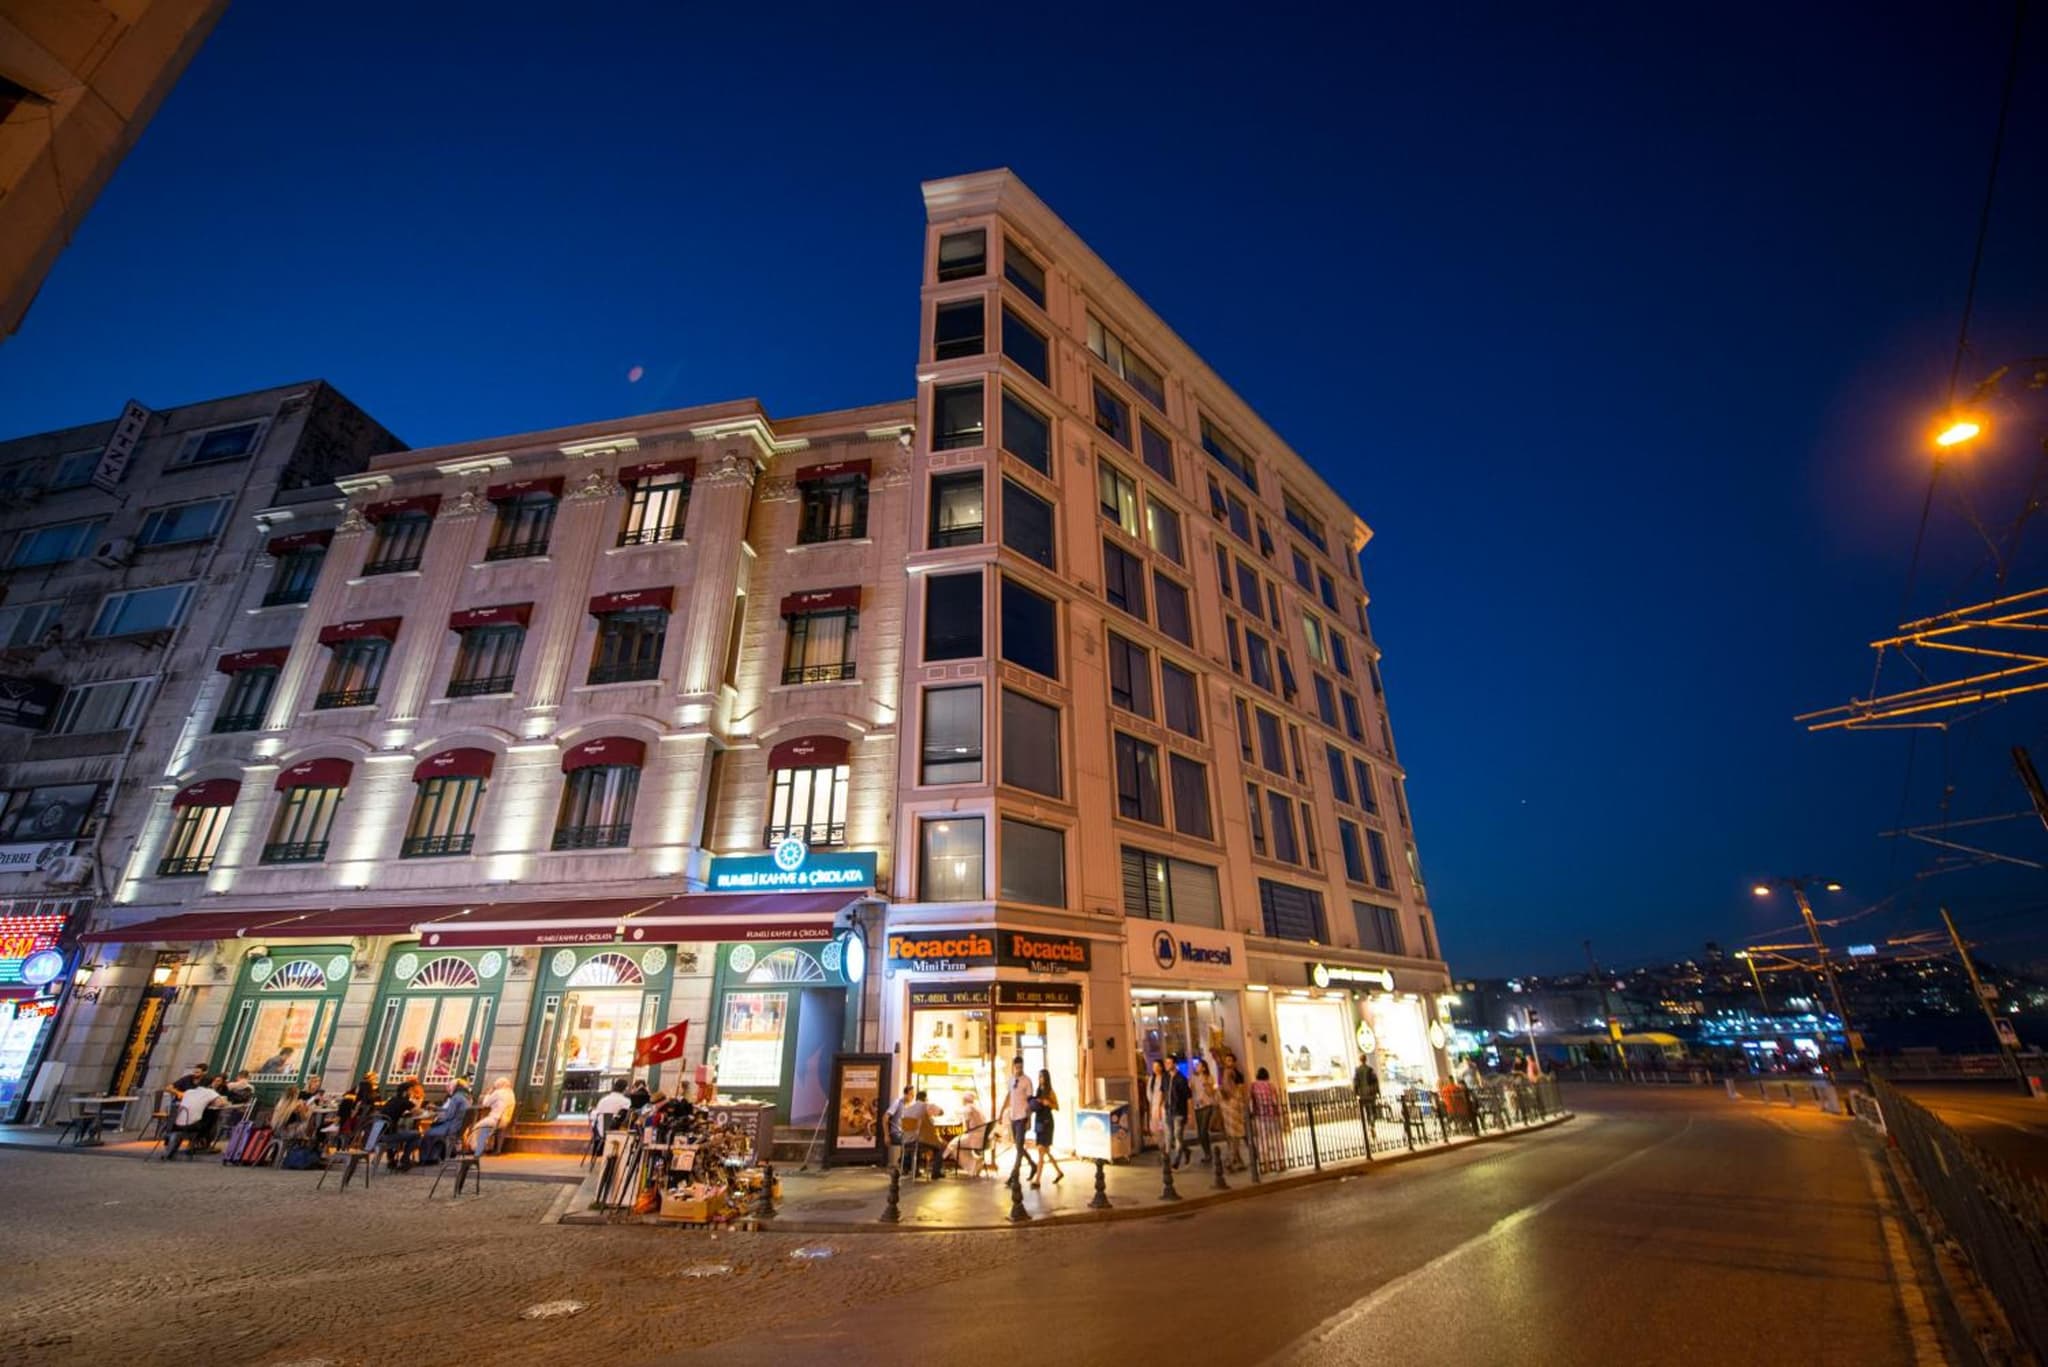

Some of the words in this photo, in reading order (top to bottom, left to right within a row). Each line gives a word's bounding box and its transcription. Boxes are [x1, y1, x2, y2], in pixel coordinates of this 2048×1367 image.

[759, 873, 796, 885] KAHVE
[798, 872, 808, 883] &
[889, 933, 993, 959] Focaccia
[1013, 935, 1085, 962] Focaccia
[912, 960, 940, 971] Mini
